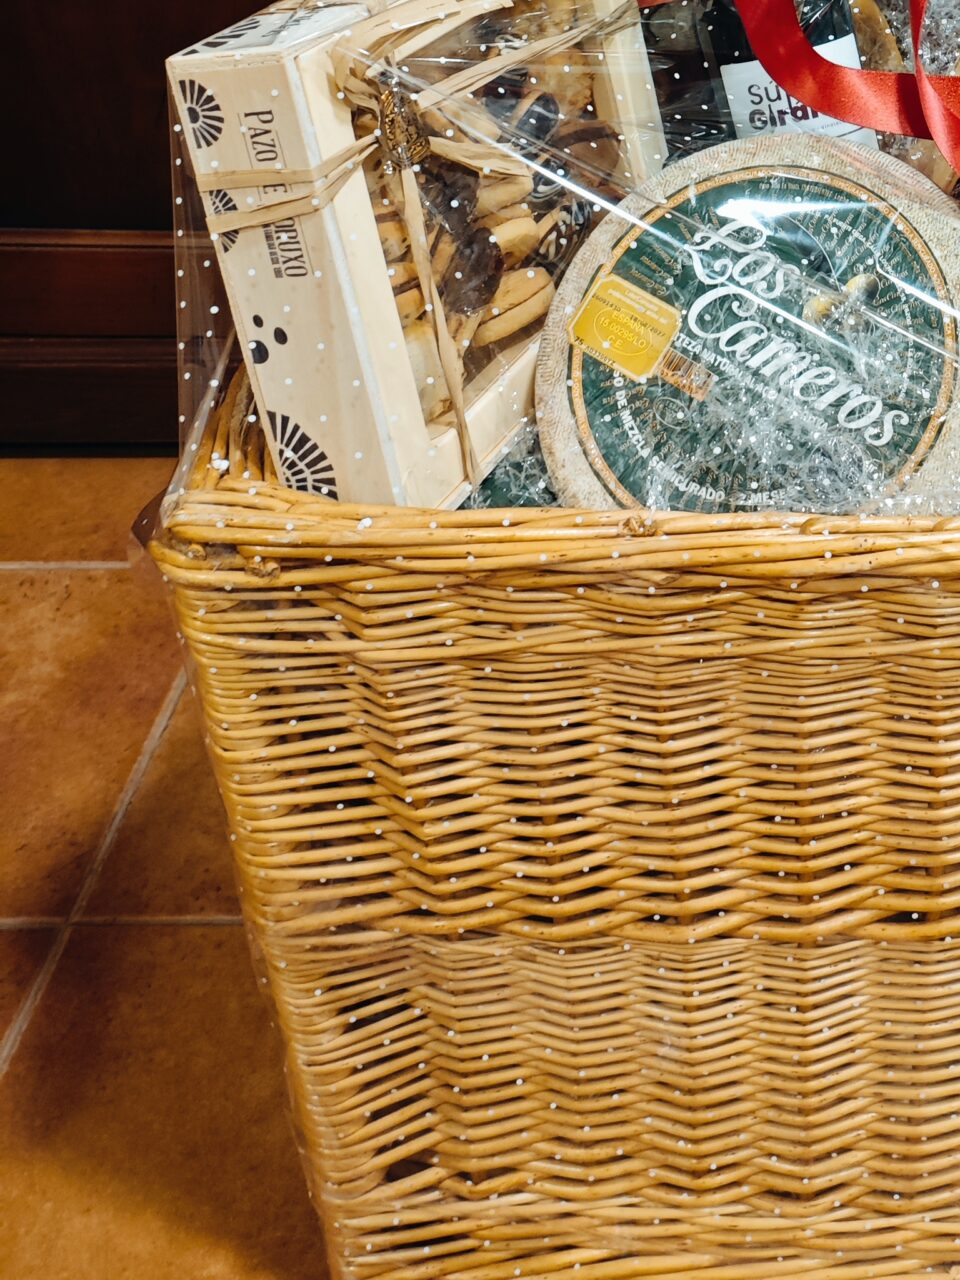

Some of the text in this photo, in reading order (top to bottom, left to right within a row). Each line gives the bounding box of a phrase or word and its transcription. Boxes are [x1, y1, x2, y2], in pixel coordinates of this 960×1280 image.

[244, 110, 279, 162] PAZO
[685, 219, 800, 299] Los
[687, 286, 909, 446] Cameros
